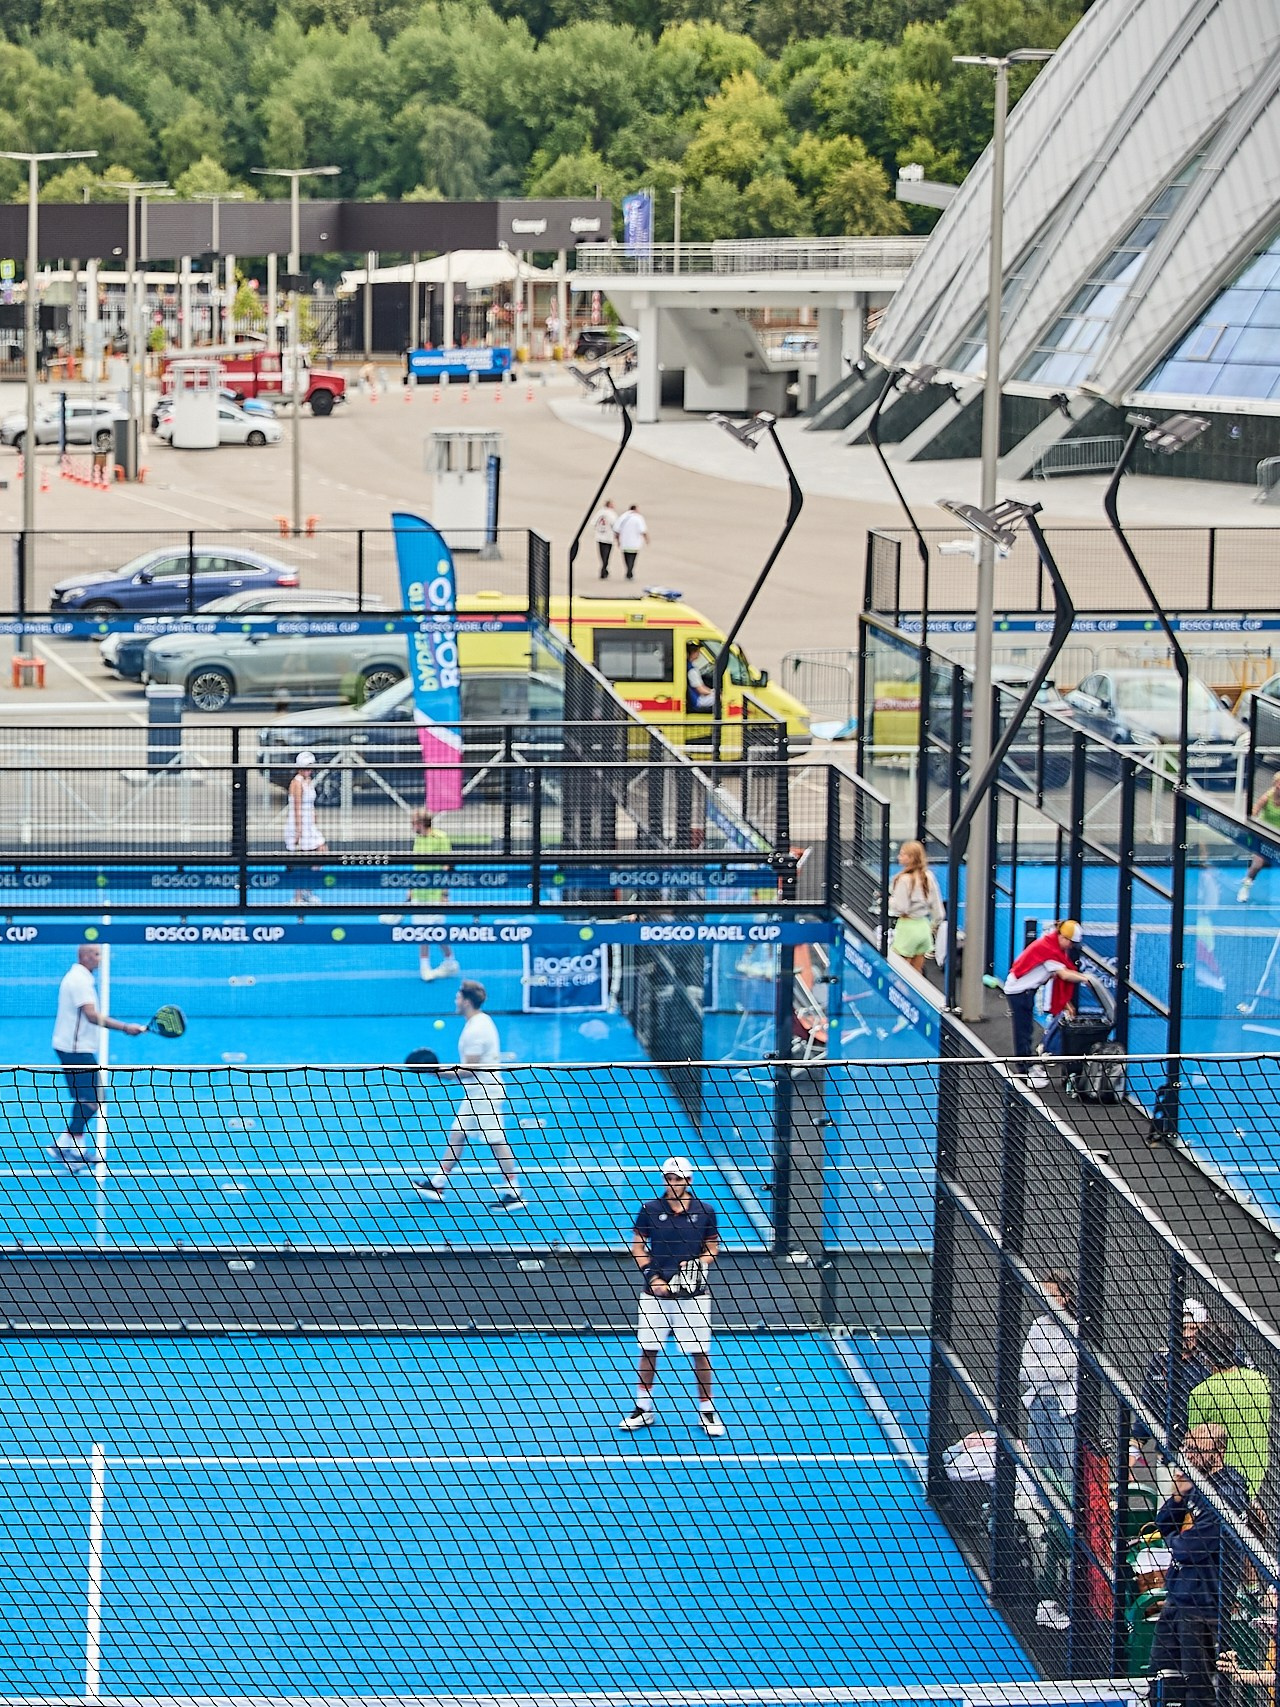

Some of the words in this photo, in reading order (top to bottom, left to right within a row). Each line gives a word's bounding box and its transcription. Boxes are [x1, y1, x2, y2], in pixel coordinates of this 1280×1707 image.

[23, 874, 52, 887] CUP
[152, 874, 201, 887] BOSCO
[205, 874, 240, 887] PADE
[251, 874, 280, 887] CUP
[380, 873, 431, 886] BOSCO
[433, 873, 477, 886] PADEL
[480, 873, 508, 886] CUP
[610, 872, 659, 885] BOSCO
[662, 872, 704, 885] PADEL
[709, 872, 736, 885] CUP
[6, 927, 38, 941] CUP
[145, 927, 199, 941] BOSCO
[202, 927, 250, 941] PADEL
[252, 927, 284, 941] CUP
[392, 927, 447, 941] BOSCO
[449, 927, 497, 941] PADEL
[500, 927, 533, 941] CUP
[640, 926, 695, 940] BOSCO
[698, 926, 746, 940] PADEL
[749, 926, 781, 940] CUP
[534, 955, 597, 974] BOSCO
